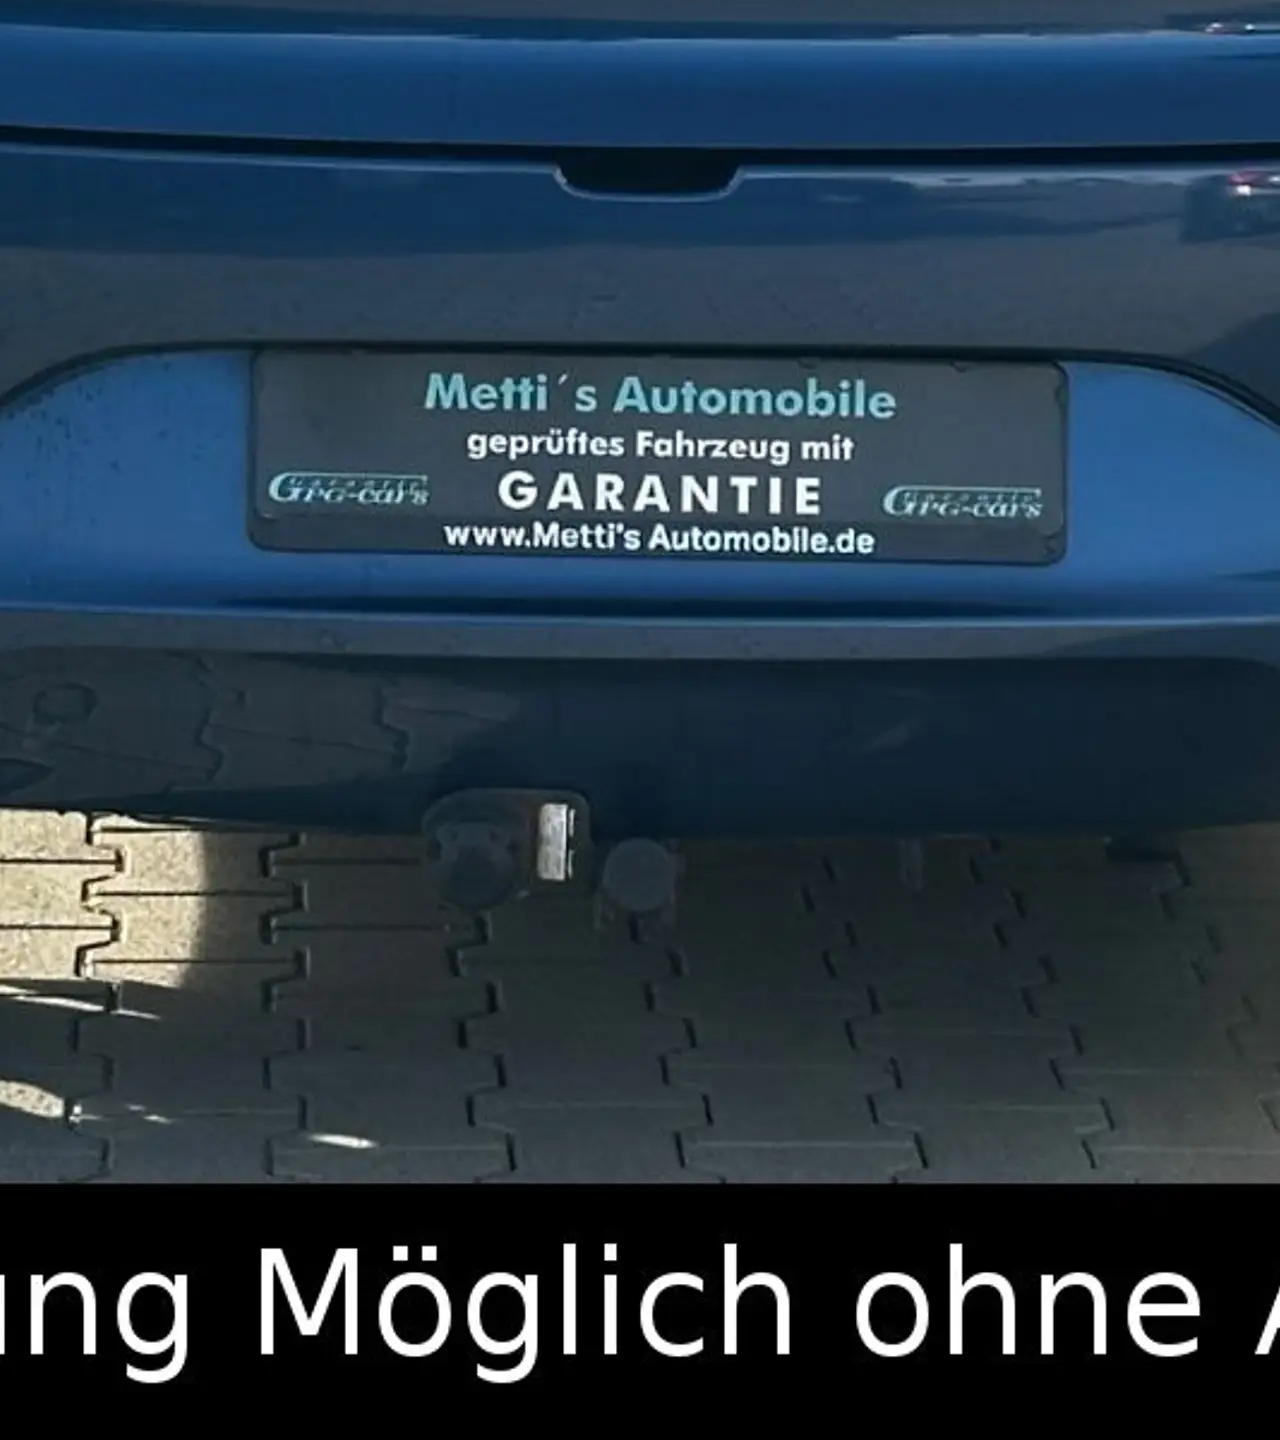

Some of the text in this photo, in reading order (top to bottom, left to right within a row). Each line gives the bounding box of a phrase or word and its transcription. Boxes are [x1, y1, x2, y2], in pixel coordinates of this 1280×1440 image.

[612, 375, 897, 420] Automobile
[467, 427, 855, 467] geprüftes Fahrzeug mit
[497, 469, 821, 516] GARANTIE
[443, 520, 876, 554] www.Metti's Automobile.de
